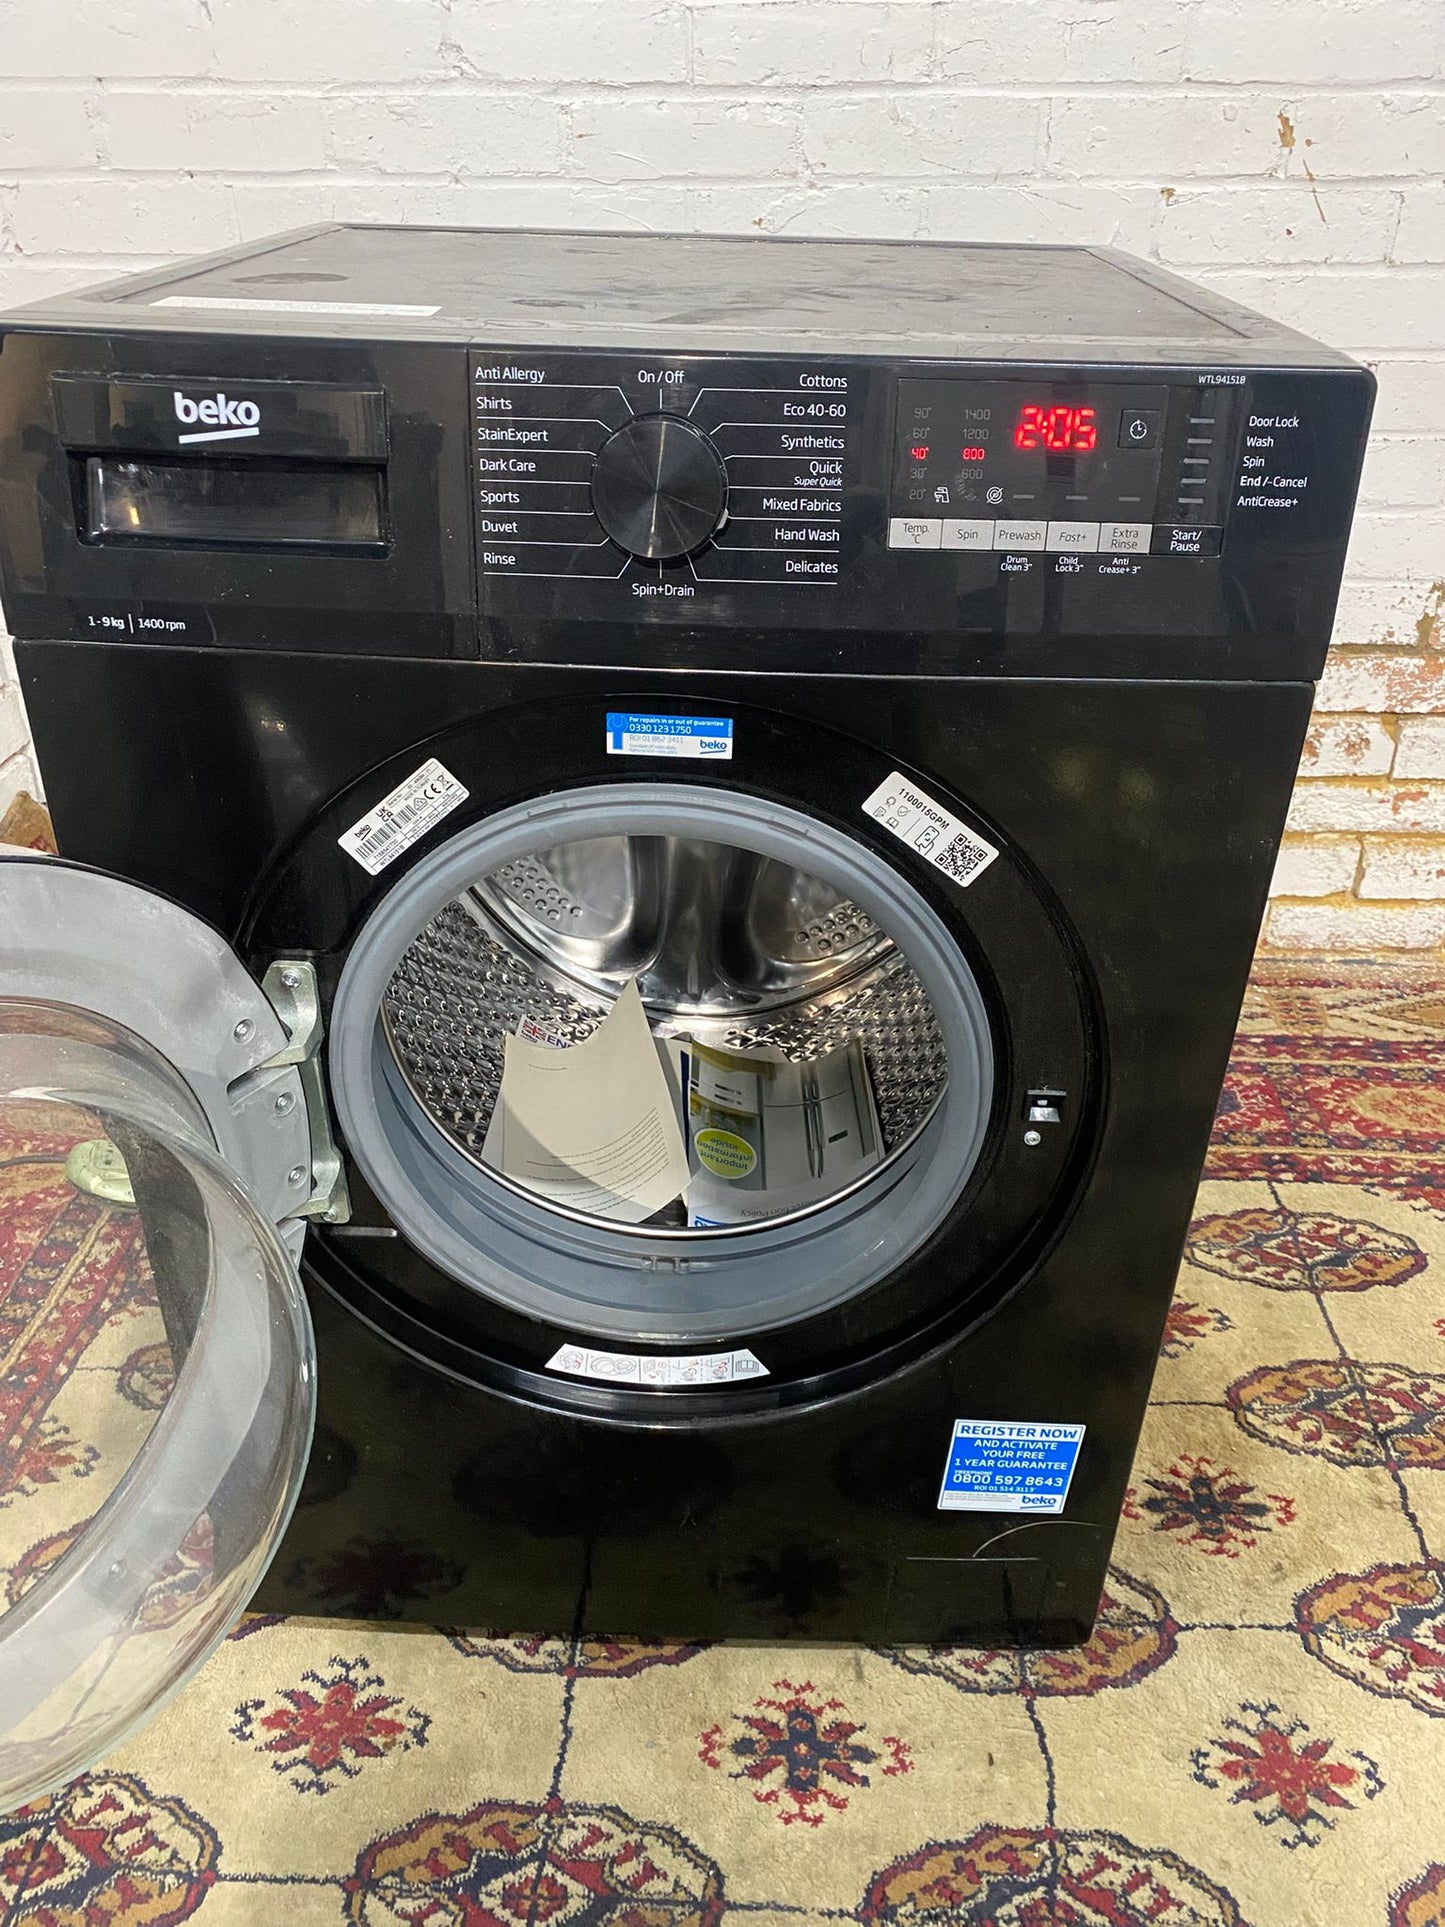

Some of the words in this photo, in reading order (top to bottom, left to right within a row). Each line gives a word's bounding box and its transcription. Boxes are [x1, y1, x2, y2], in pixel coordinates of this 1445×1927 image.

[475, 366, 500, 379] Anti
[502, 367, 545, 383] Allergy
[638, 370, 657, 383] On
[665, 371, 685, 383] Off
[1198, 375, 1246, 385] WTL94151B
[799, 374, 848, 388] Cottons
[173, 392, 260, 426] beko
[476, 397, 512, 410] Shirts
[783, 403, 805, 416] Eco
[806, 404, 846, 417] 40-60
[964, 408, 991, 420] 1400
[1249, 415, 1274, 427] Door
[1275, 416, 1299, 428] Lock
[962, 428, 989, 440] 1200
[1015, 406, 1097, 450] 2:05
[478, 428, 548, 443] StainExpert
[1246, 436, 1274, 447] Wash
[781, 435, 845, 450] Synthetics
[962, 447, 985, 460] 800
[479, 459, 507, 471] Dark
[509, 460, 536, 472] Care
[809, 461, 843, 475] Quick
[1242, 456, 1265, 468] Spin
[961, 468, 983, 480] 600
[794, 477, 819, 487] Super
[819, 477, 843, 487] Quick
[1240, 475, 1260, 487] End
[480, 490, 520, 504] Sports
[1237, 496, 1299, 508] AntiCrease+
[763, 498, 798, 511] Mixed
[800, 499, 842, 512] Fabrics
[482, 520, 518, 533] Duvet
[903, 523, 930, 535] Temp.
[775, 528, 806, 541] Hand
[808, 529, 840, 541] Wash
[957, 529, 979, 541] Spin
[999, 530, 1042, 541] Prewash
[1059, 531, 1087, 543] Fast+
[1112, 528, 1139, 538] Extra
[1172, 529, 1202, 540] Start/
[1110, 539, 1138, 549] Rinse
[1170, 541, 1200, 552] Pause
[483, 552, 516, 565] Rinse
[1006, 555, 1028, 563] Drum
[1059, 556, 1079, 564] Child
[1112, 557, 1130, 565] Anti
[785, 560, 839, 573] Delicates
[1000, 563, 1022, 571] Clean
[1055, 564, 1073, 572] Lock
[1098, 565, 1130, 574] Crease+
[632, 583, 695, 597] Spin+Drain
[138, 618, 165, 629] 1400
[166, 621, 186, 632] rpm
[629, 723, 651, 732] 0330
[653, 724, 669, 733] 123
[670, 726, 692, 734] 1750
[699, 739, 728, 750] beko
[898, 788, 950, 831] 1100015GPM
[354, 824, 371, 838] beko
[696, 1140, 753, 1162] information
[700, 1151, 748, 1170] Important
[960, 1424, 1036, 1438] REGISTER
[1039, 1427, 1078, 1439] NOW
[974, 1439, 1000, 1448] AND
[1001, 1440, 1058, 1450] ACTIVATE
[983, 1449, 1014, 1458] YOUR
[1016, 1450, 1045, 1459] FREE
[954, 1458, 961, 1466] 1
[964, 1458, 995, 1467] YEAR
[997, 1460, 1068, 1470] GUARANTEE
[953, 1473, 991, 1484] 0800
[994, 1475, 1022, 1485] 597
[1025, 1476, 1064, 1487] 8643
[1021, 1495, 1057, 1505] beko
